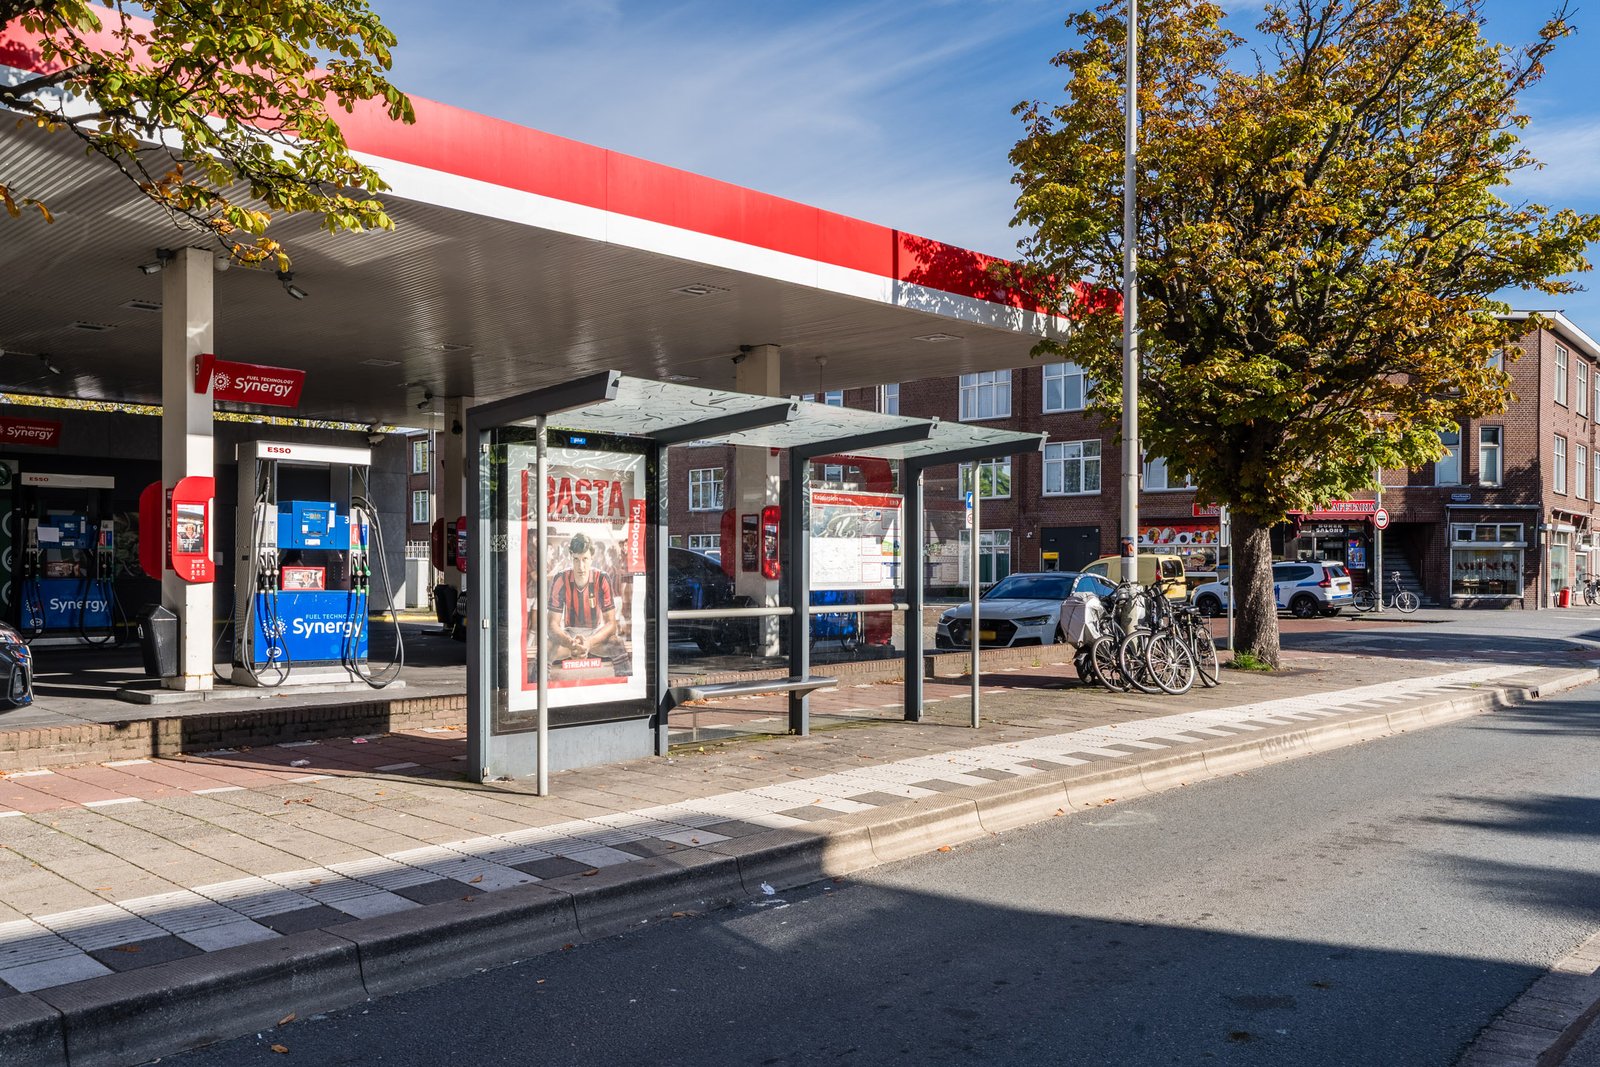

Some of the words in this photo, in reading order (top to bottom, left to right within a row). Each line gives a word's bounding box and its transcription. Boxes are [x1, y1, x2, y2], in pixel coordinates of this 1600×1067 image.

[234, 377, 292, 397] Synergy
[260, 376, 294, 385] TECHNOLOGY
[7, 426, 53, 440] Synergy
[267, 446, 292, 454] ESSO
[50, 598, 108, 613] Synergy
[292, 618, 363, 638] Synergy
[563, 661, 590, 669] STREAM
